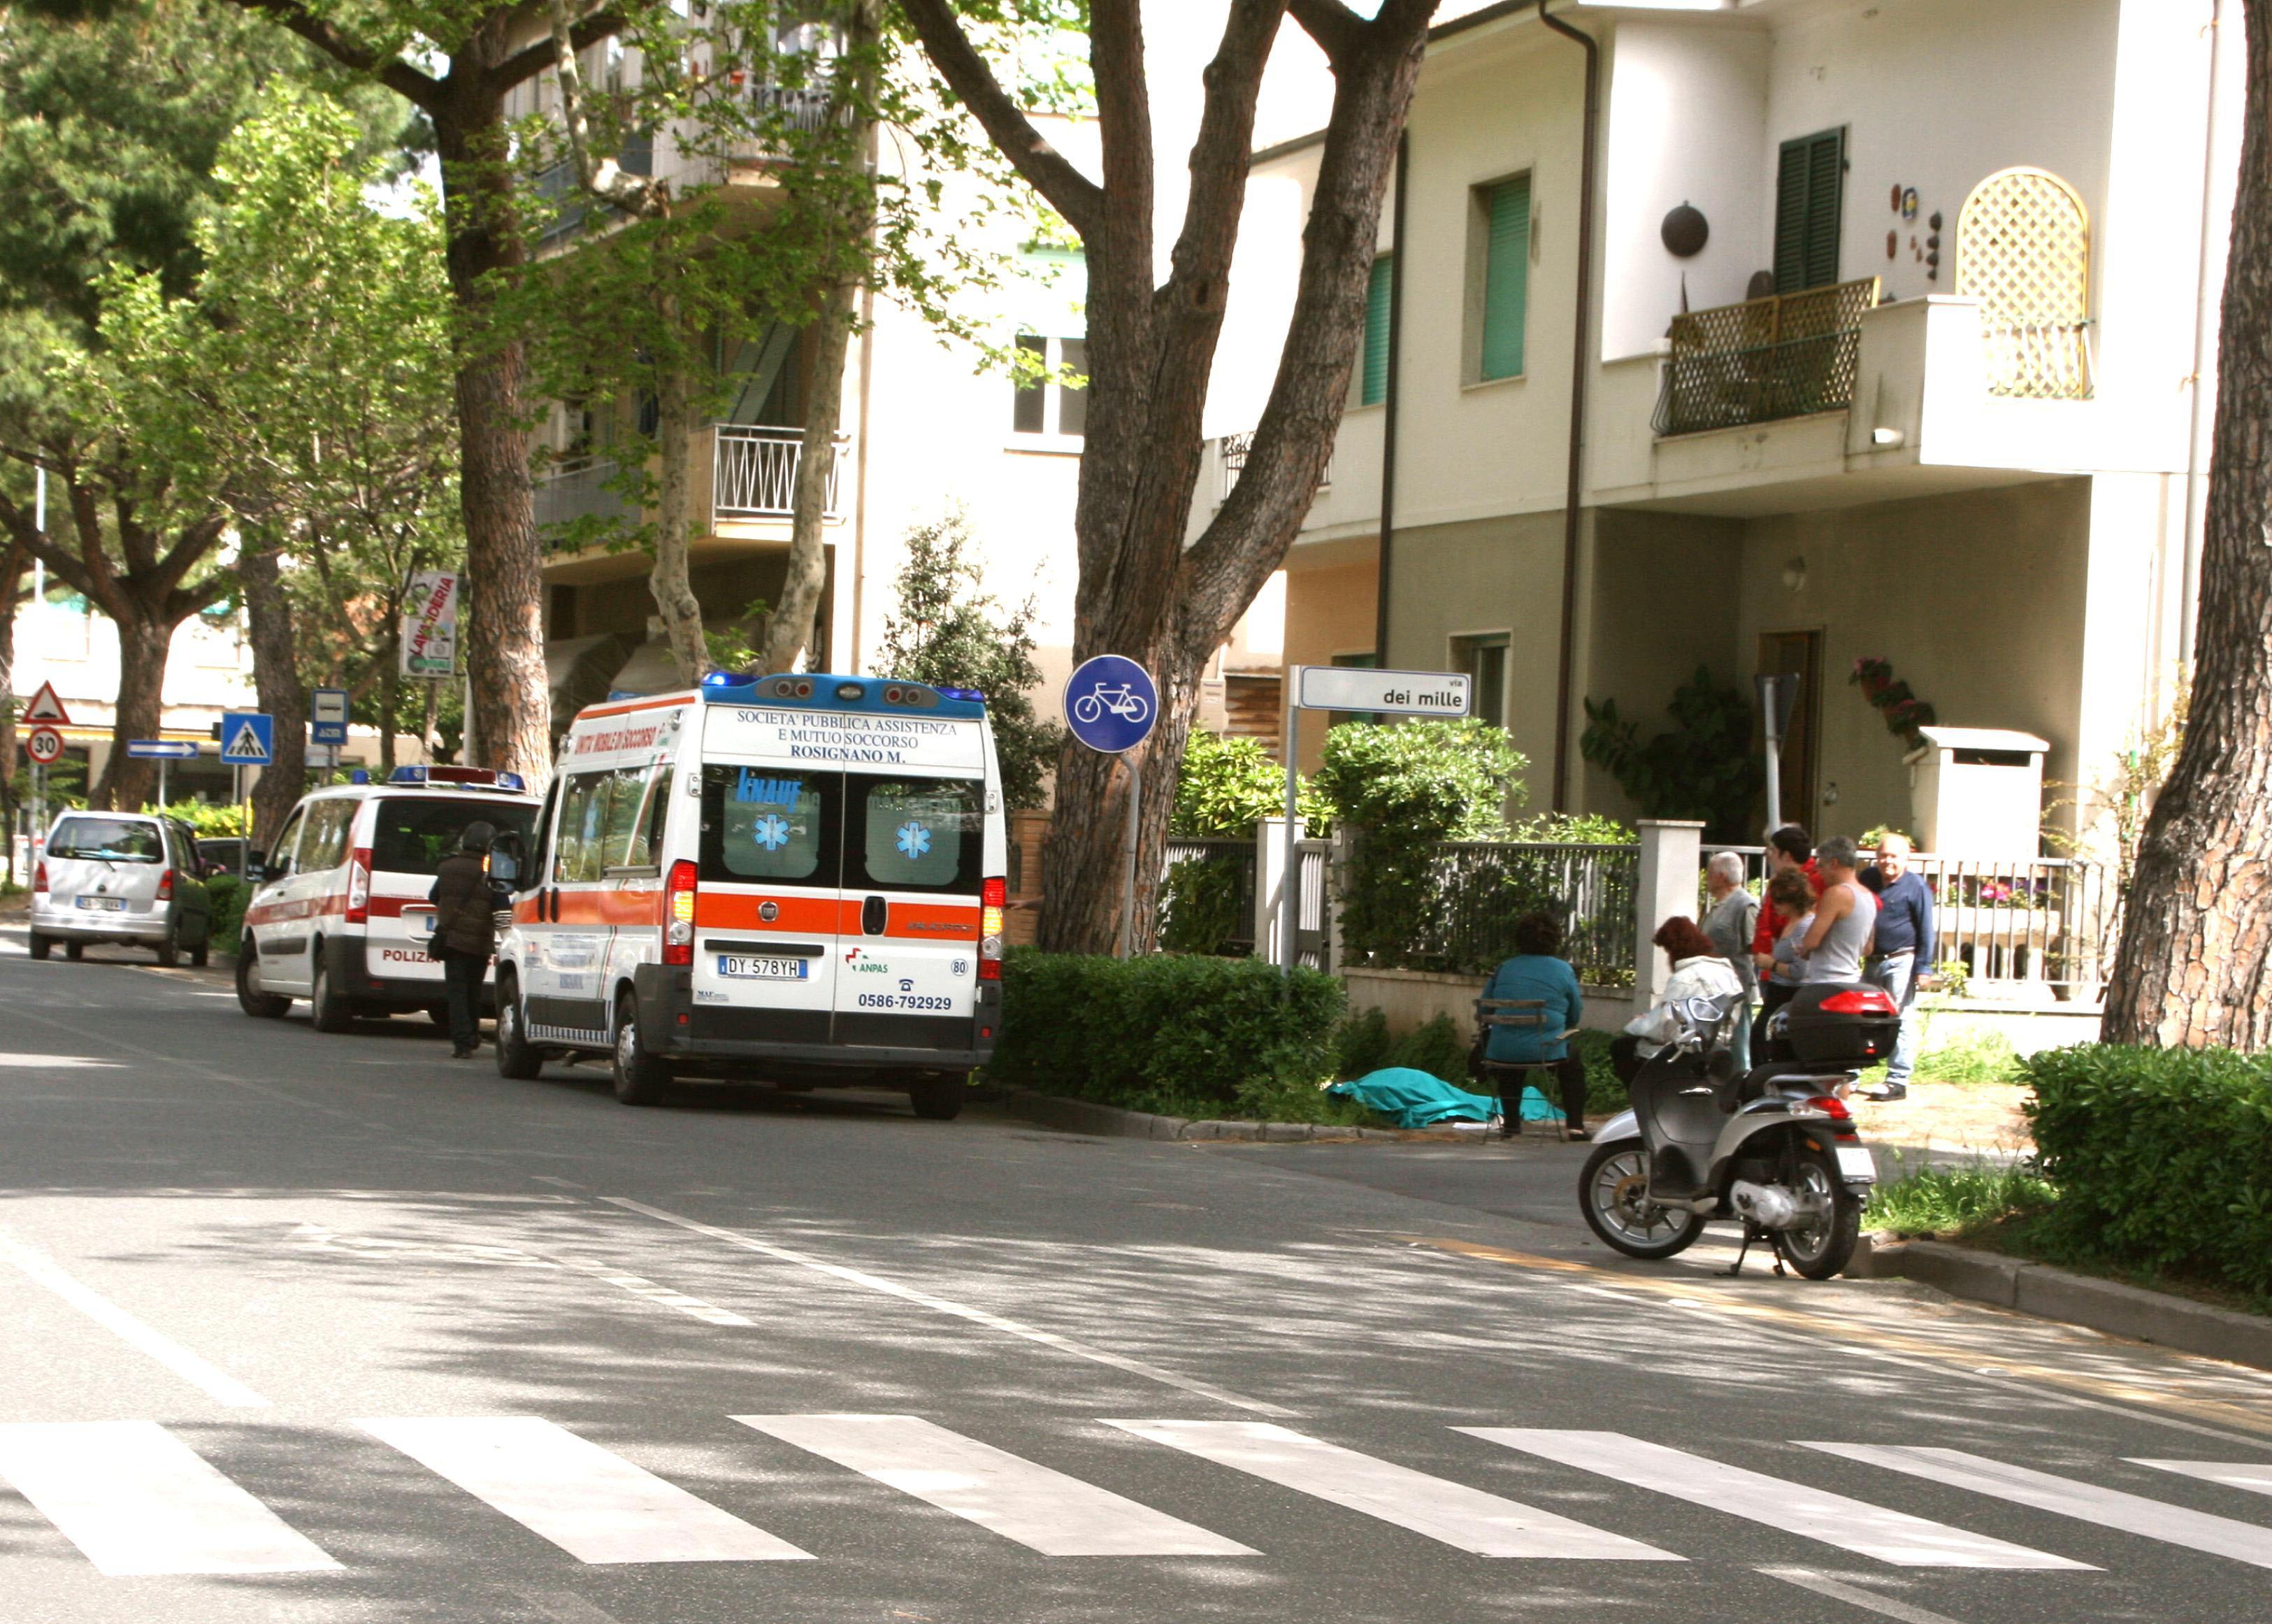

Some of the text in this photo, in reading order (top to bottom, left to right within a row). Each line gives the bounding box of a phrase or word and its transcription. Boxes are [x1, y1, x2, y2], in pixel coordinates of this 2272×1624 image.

[410, 577, 454, 656] LAVADERIA
[1449, 679, 1462, 687] via
[1383, 689, 1462, 707] dei mille
[738, 710, 957, 735] SOCIETA' PUBBLICA ASSISTENZA
[36, 737, 55, 753] 30
[778, 728, 919, 749] E MUTUO SOCCORSO
[791, 745, 906, 763] ROSIGNANO M.
[729, 958, 797, 975] DY 578YH
[859, 963, 889, 973] ANPAS
[954, 962, 965, 972] 80
[858, 993, 951, 1009] 0586-792929
